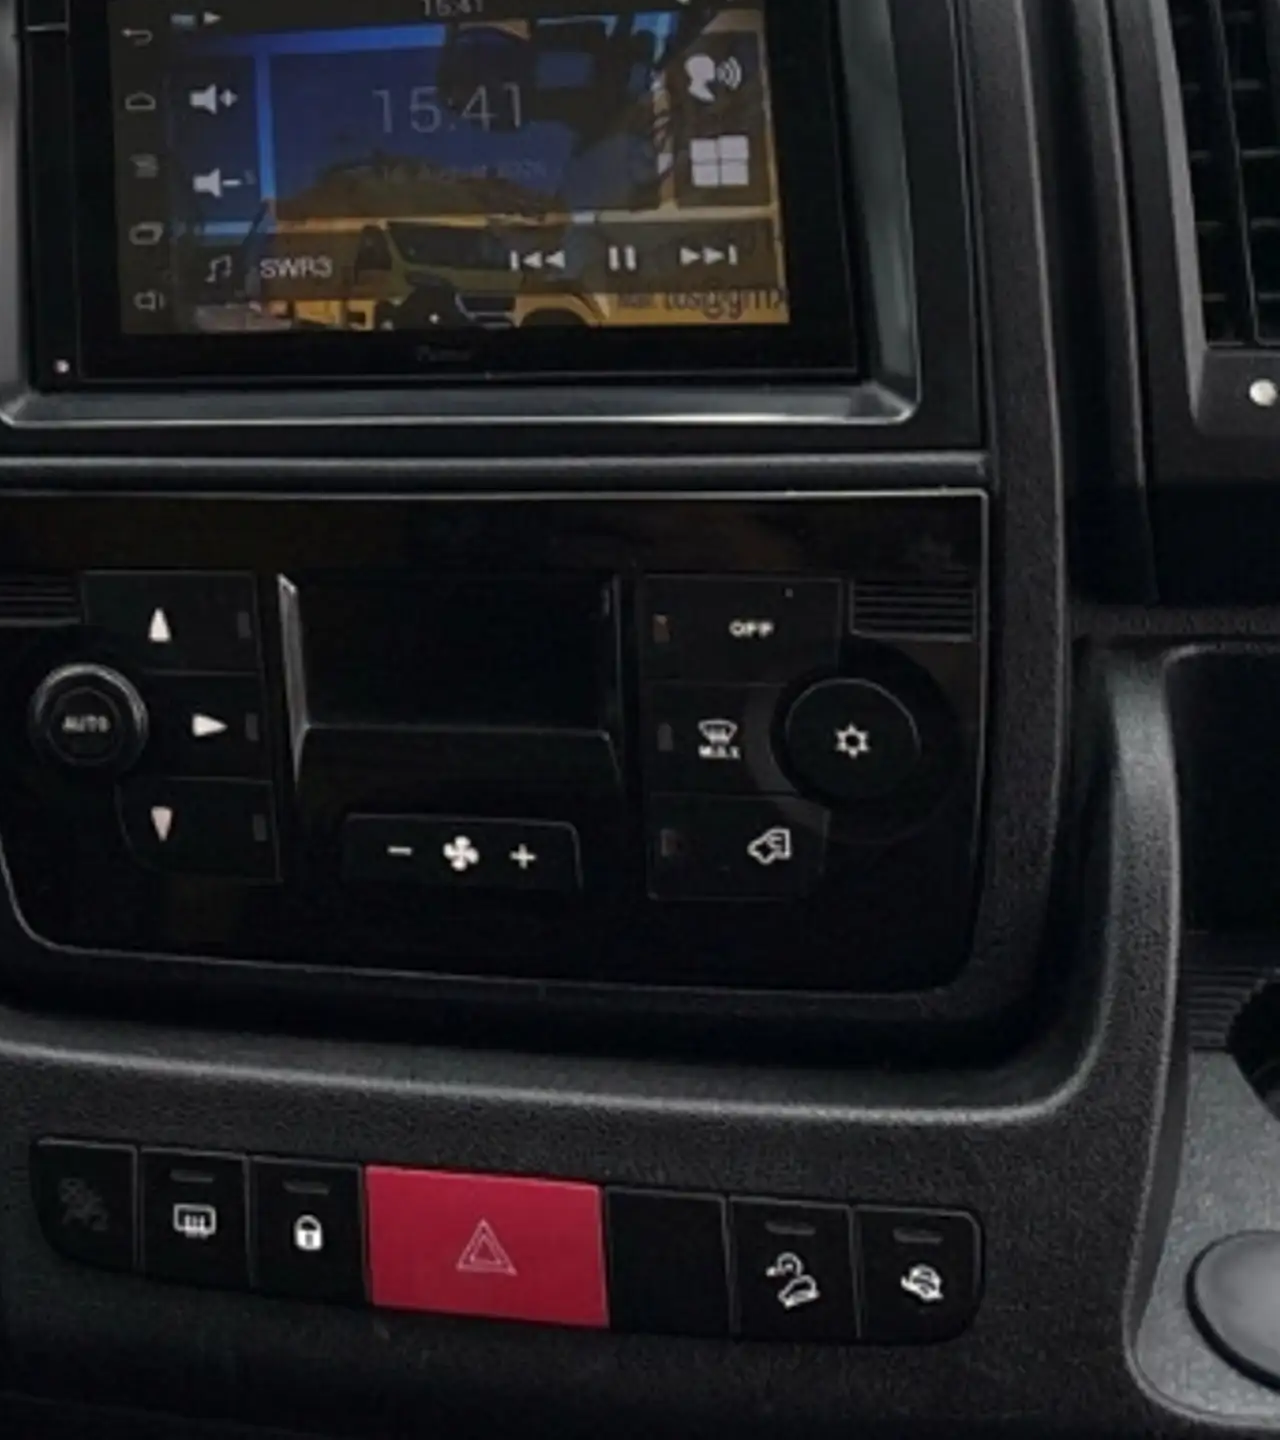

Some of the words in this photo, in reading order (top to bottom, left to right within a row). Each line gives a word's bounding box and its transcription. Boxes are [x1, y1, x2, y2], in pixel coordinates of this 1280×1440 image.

[372, 82, 521, 133] 15:41
[259, 254, 333, 279] SWR3
[728, 619, 775, 639] OFF
